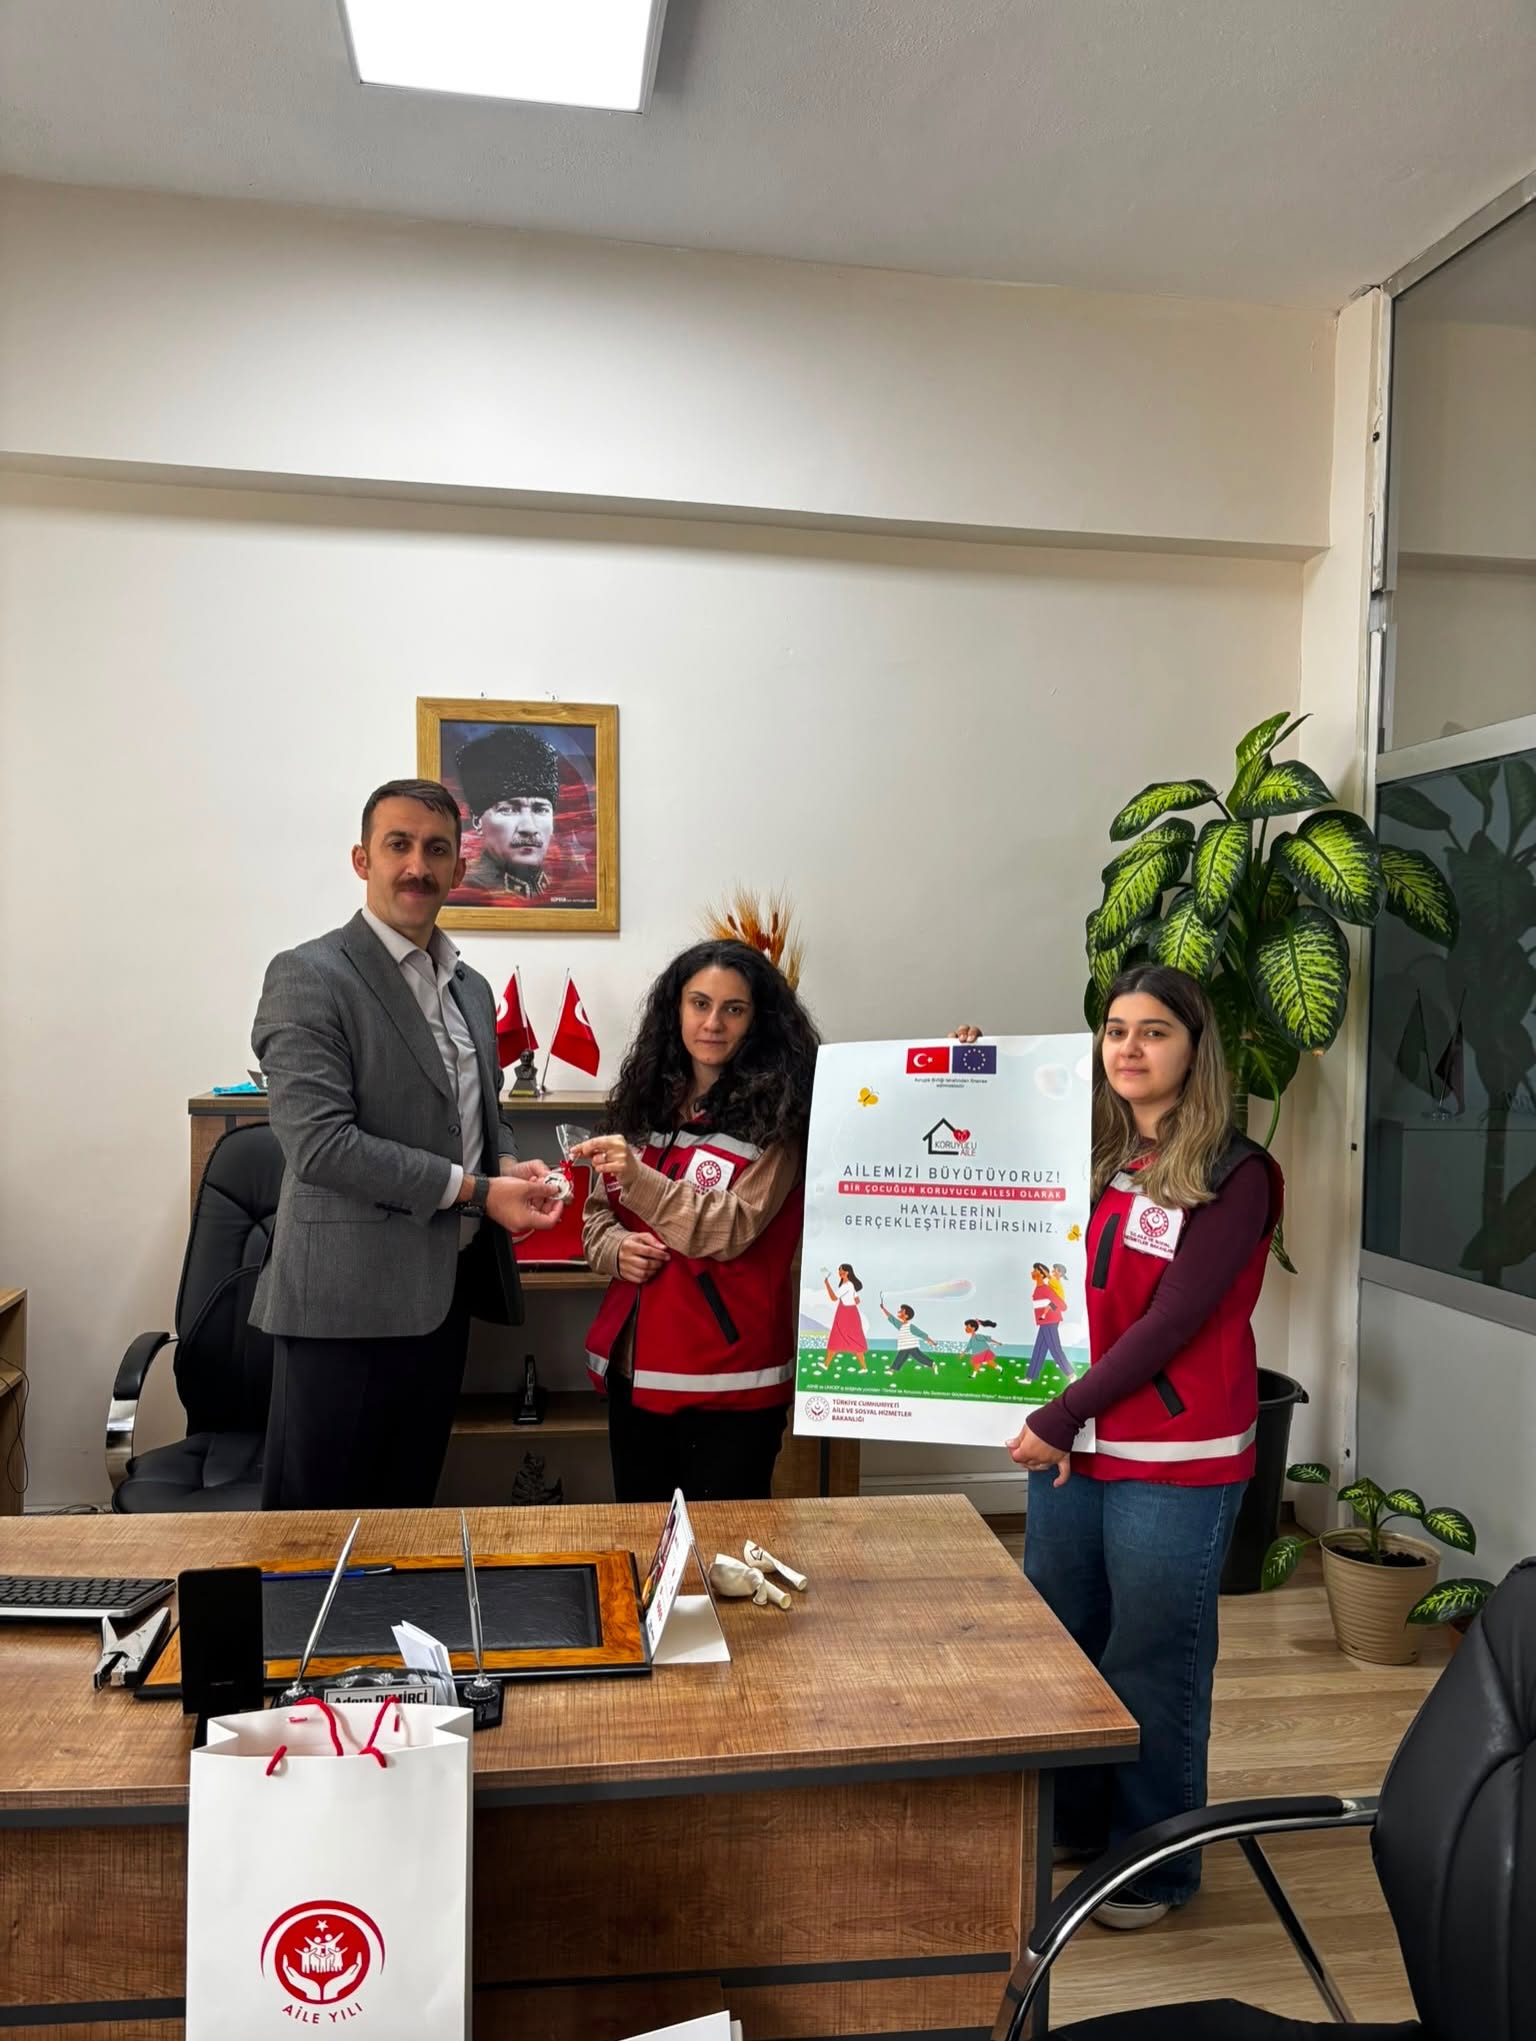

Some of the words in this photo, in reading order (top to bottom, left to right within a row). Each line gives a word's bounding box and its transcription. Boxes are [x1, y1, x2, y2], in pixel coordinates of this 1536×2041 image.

[843, 1163, 919, 1178] AİLEMİZİ
[929, 1166, 1060, 1183] BÜYÜTÜYORUZ!
[843, 1183, 860, 1192] BİR
[865, 1184, 915, 1194] ÇOCUĞUN
[920, 1186, 977, 1196] KORUYUCU
[982, 1188, 1015, 1197] AİLESİ
[1020, 1190, 1061, 1199] OLARAK
[900, 1204, 1001, 1218] HAYALLERİNİ
[844, 1215, 1058, 1234] GERÇEKLEŞTİREBİLİRSİNİZ.
[832, 1399, 857, 1407] TÜRKİYE
[858, 1400, 900, 1409] CUMHURİYETİ
[832, 1415, 865, 1423] BAKANLIĞI
[855, 1408, 877, 1416] SOSYAL
[878, 1409, 913, 1418] HİZMETLER
[282, 2004, 320, 2024] AİLE
[328, 2002, 363, 2023] YILI
